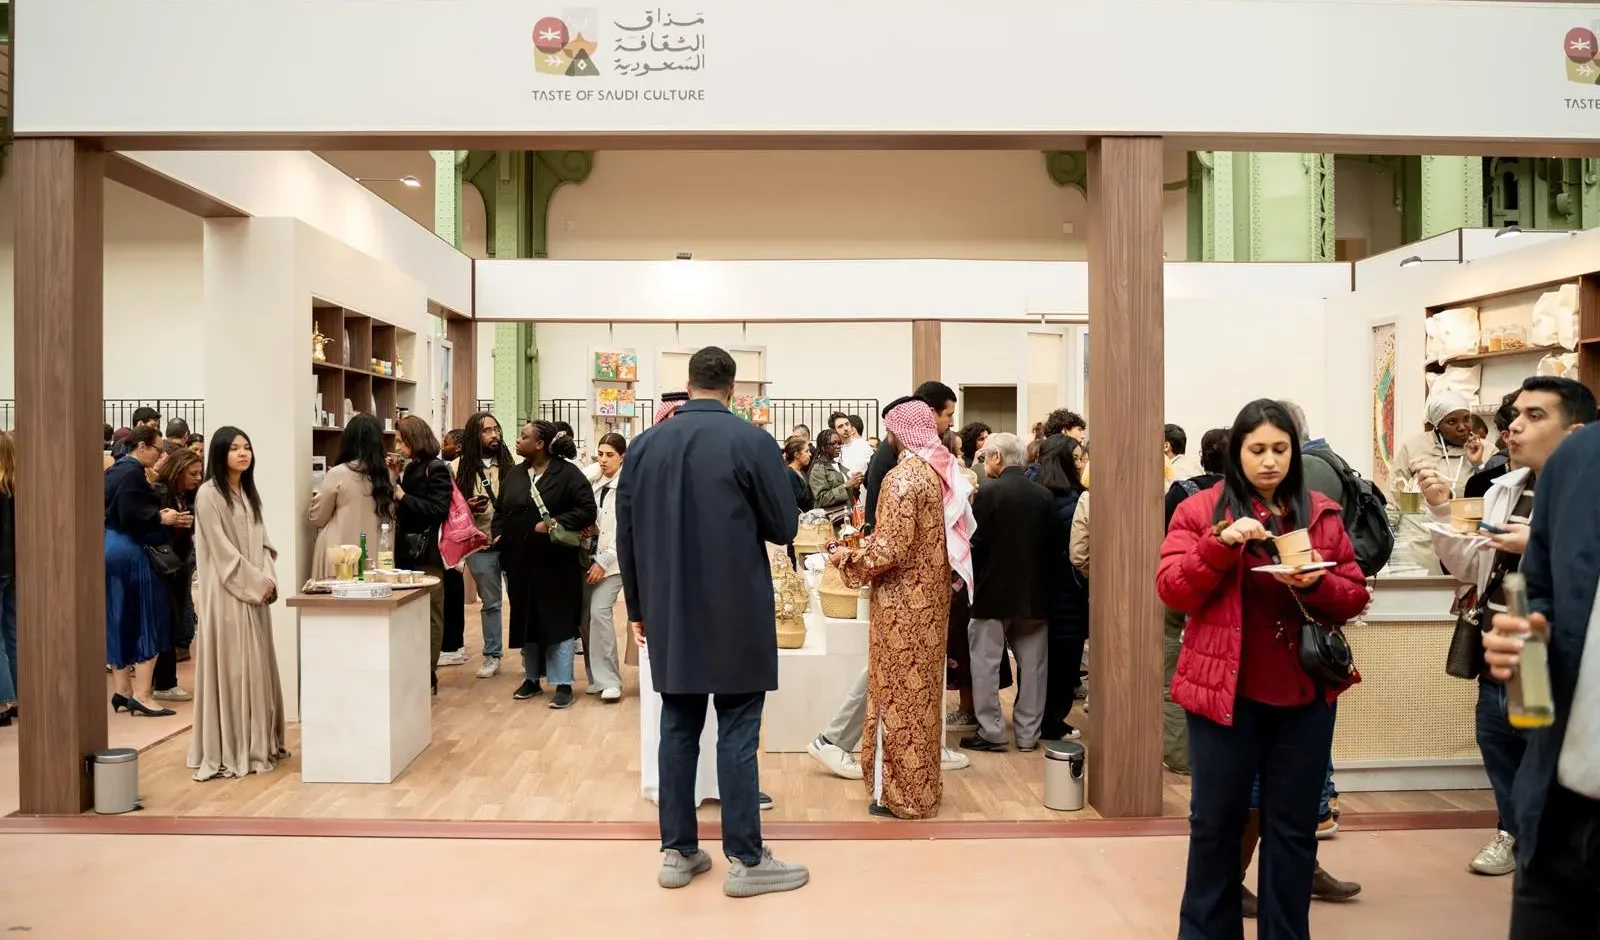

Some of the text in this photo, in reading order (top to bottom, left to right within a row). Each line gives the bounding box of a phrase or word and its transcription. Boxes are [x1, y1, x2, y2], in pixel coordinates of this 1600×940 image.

[614, 32, 705, 52] الثقافة
[614, 54, 705, 77] السعودية
[532, 90, 705, 101] TASTE OF SAUDI CULTURE
